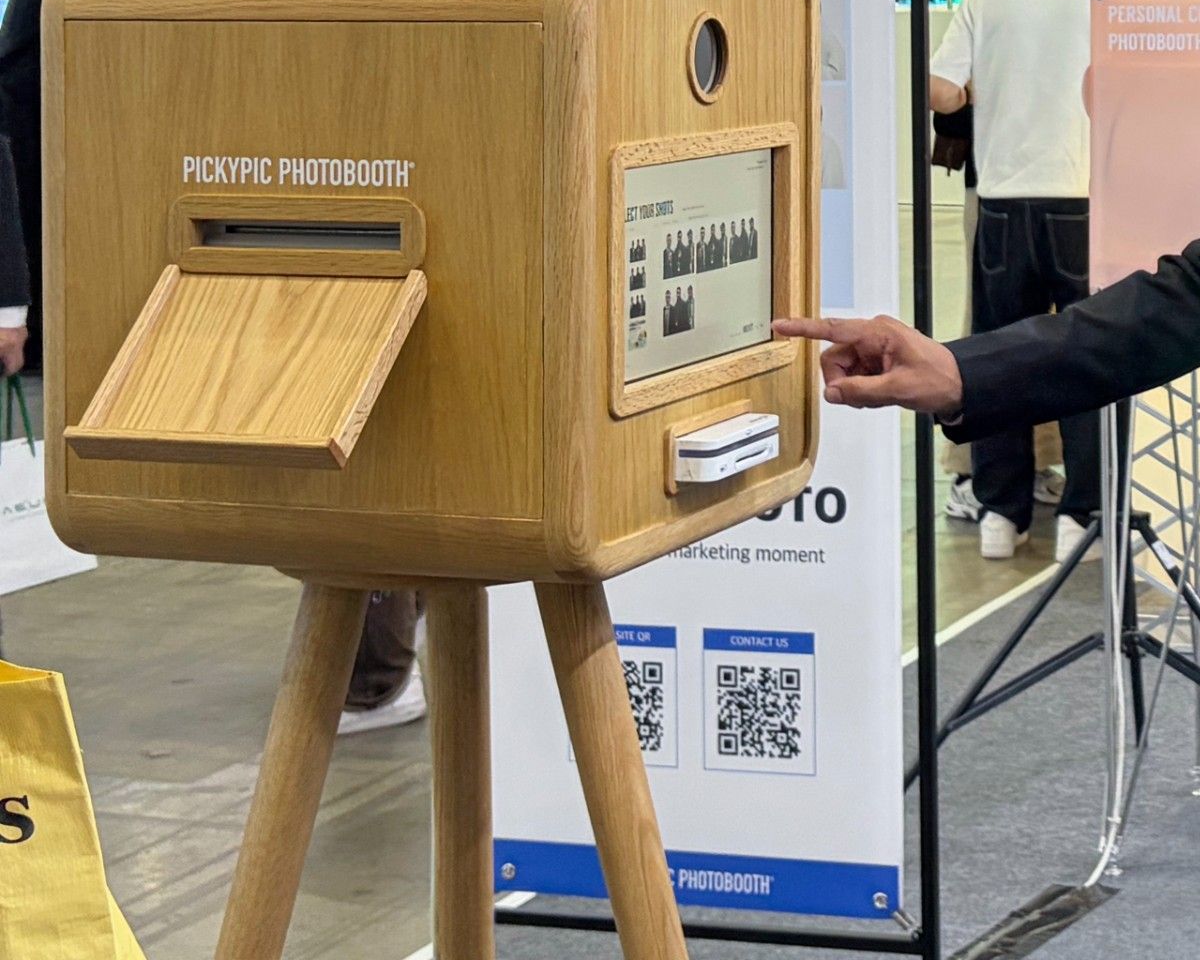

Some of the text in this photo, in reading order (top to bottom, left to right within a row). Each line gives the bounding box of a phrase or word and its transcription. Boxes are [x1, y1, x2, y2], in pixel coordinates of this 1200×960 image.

[1108, 5, 1182, 24] PERSONAL
[183, 156, 272, 184] PICKYPIC
[755, 547, 826, 563] moment
[730, 635, 789, 648] CONTACT US
